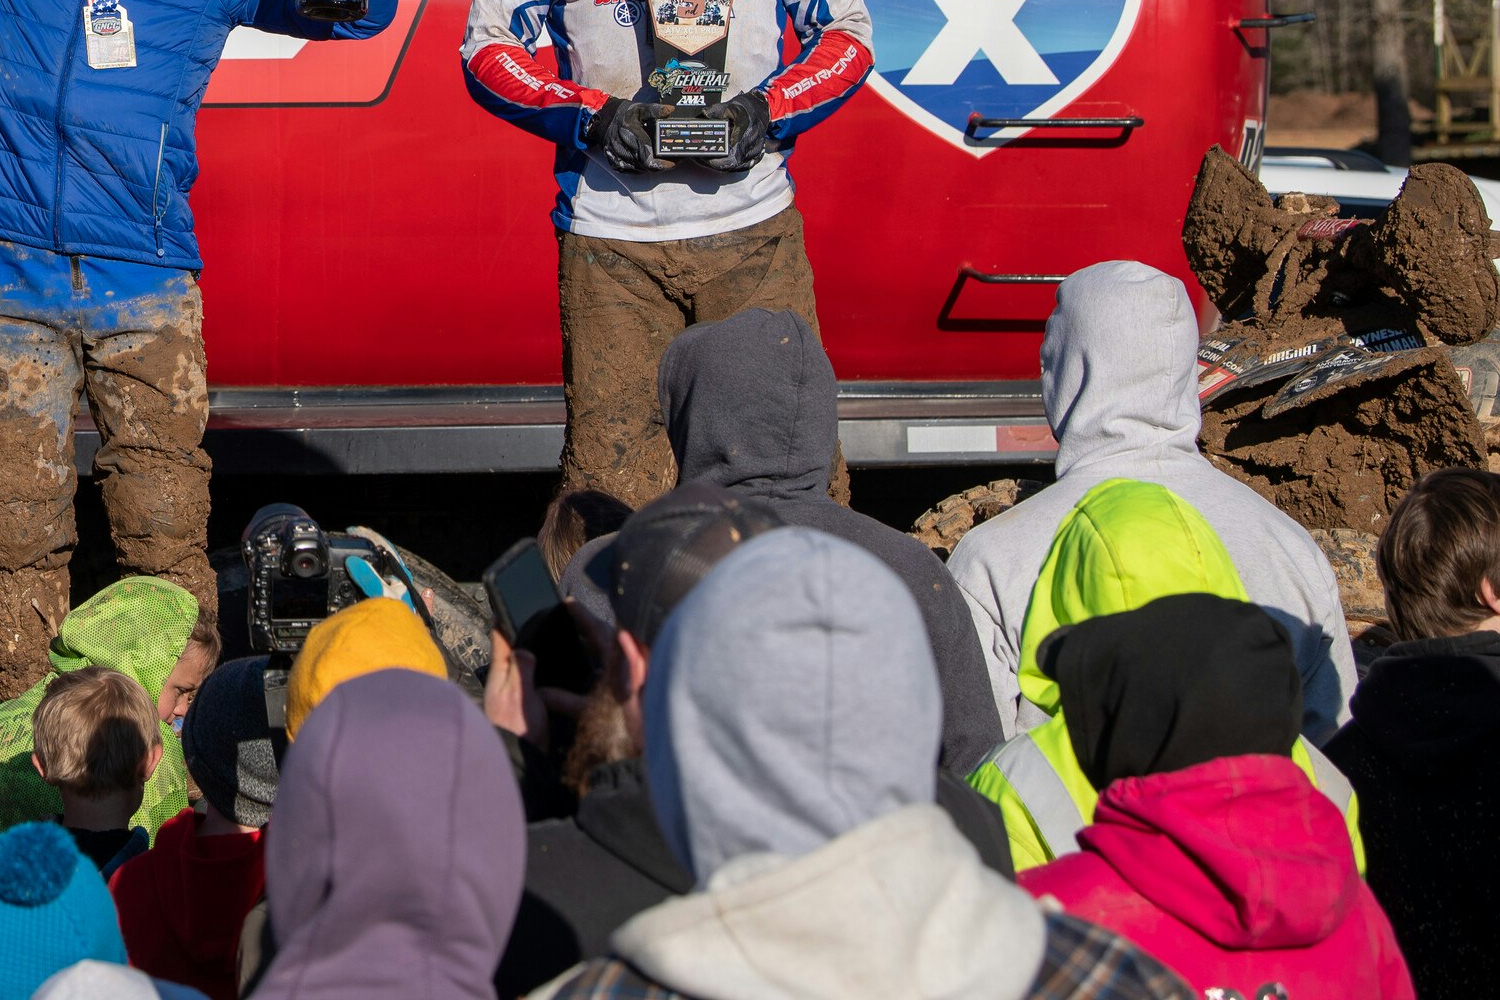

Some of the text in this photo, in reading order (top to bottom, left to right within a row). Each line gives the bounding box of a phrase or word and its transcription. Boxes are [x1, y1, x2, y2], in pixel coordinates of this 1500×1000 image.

[94, 22, 120, 30] GNCC
[495, 51, 545, 92] MOOSE
[674, 74, 730, 87] GENERAL
[676, 95, 707, 106] AMA
[1351, 328, 1408, 348] AYNES
[1374, 335, 1423, 353] YAMAH
